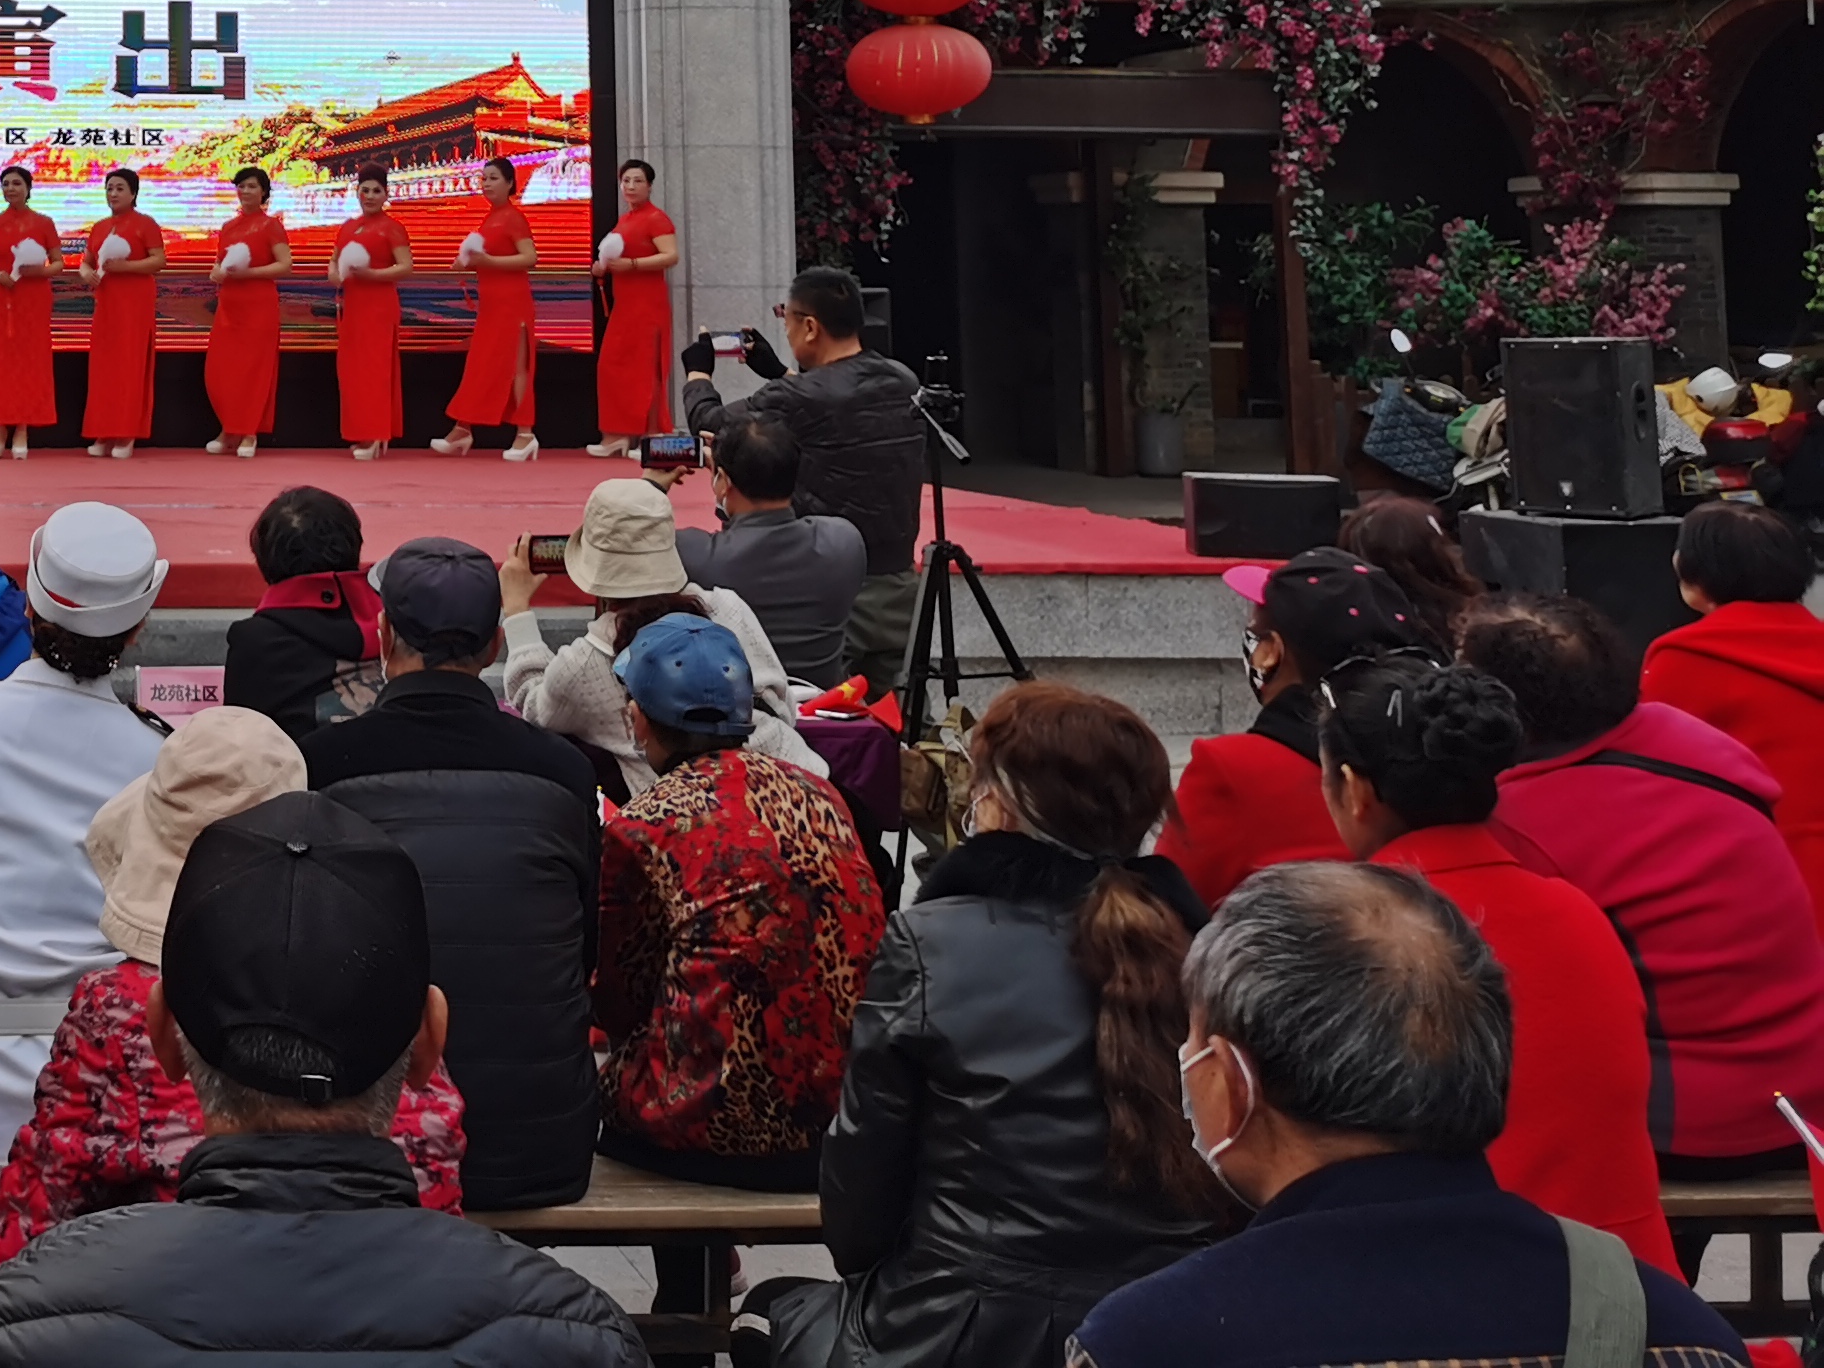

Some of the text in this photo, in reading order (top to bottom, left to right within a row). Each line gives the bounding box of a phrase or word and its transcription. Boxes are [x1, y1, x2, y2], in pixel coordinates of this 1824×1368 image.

[49, 126, 166, 147] 龙苑社区
[150, 682, 219, 702] 龙苑社区
